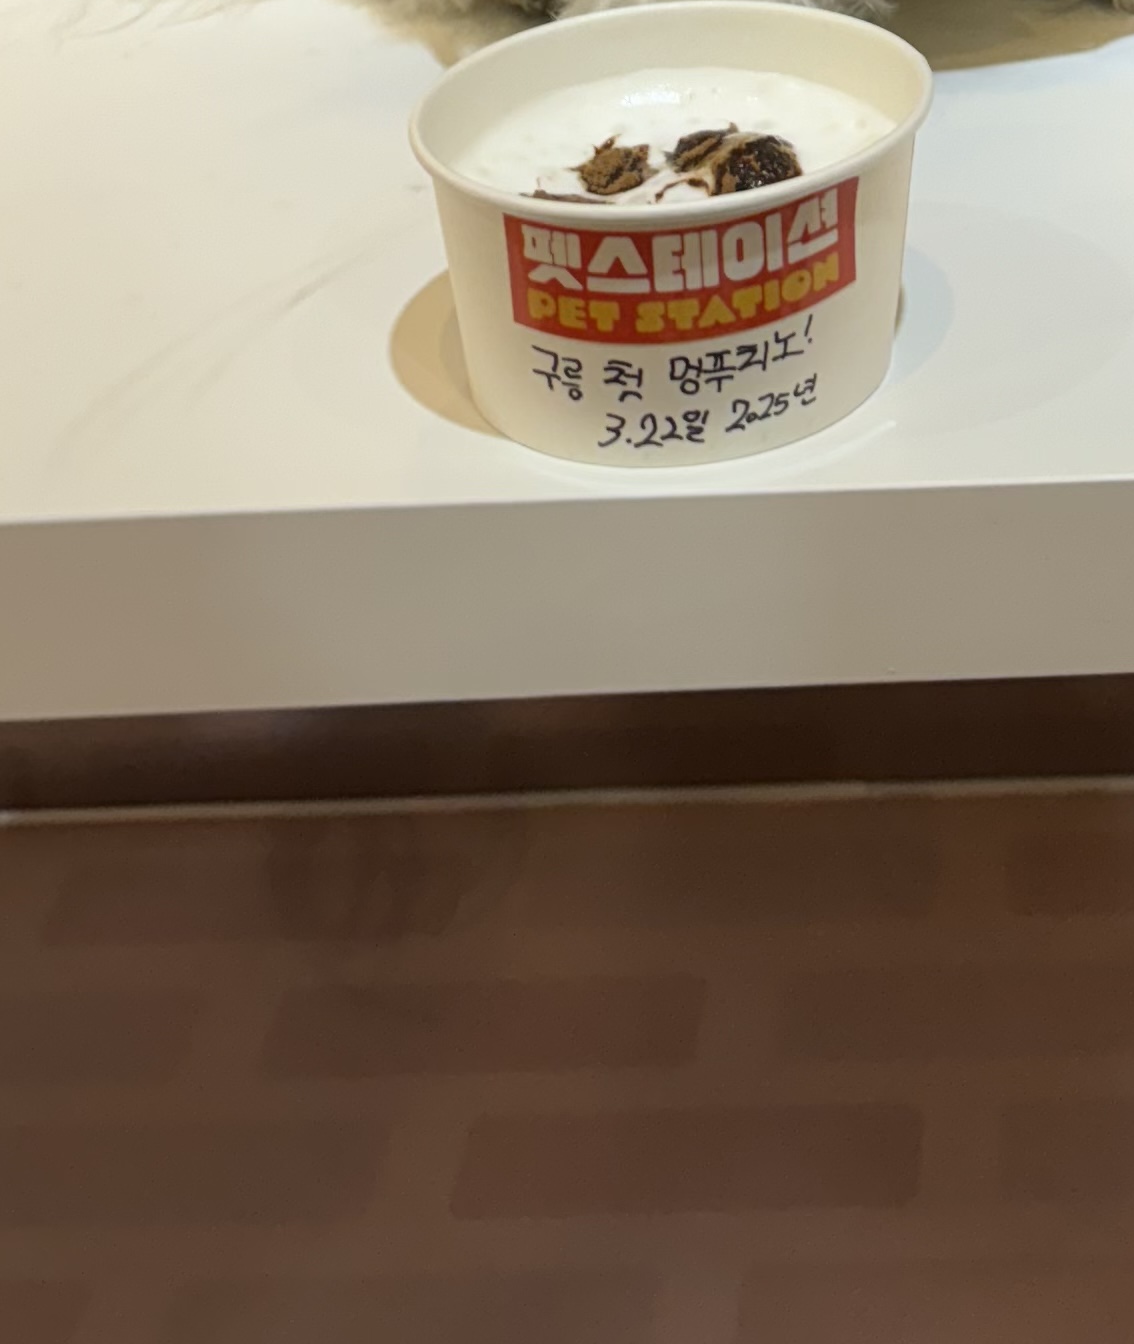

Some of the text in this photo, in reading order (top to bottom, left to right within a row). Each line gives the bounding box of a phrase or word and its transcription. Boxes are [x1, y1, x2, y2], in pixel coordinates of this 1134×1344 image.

[521, 187, 838, 294] 펫스테이션
[527, 252, 840, 334] PET STATION
